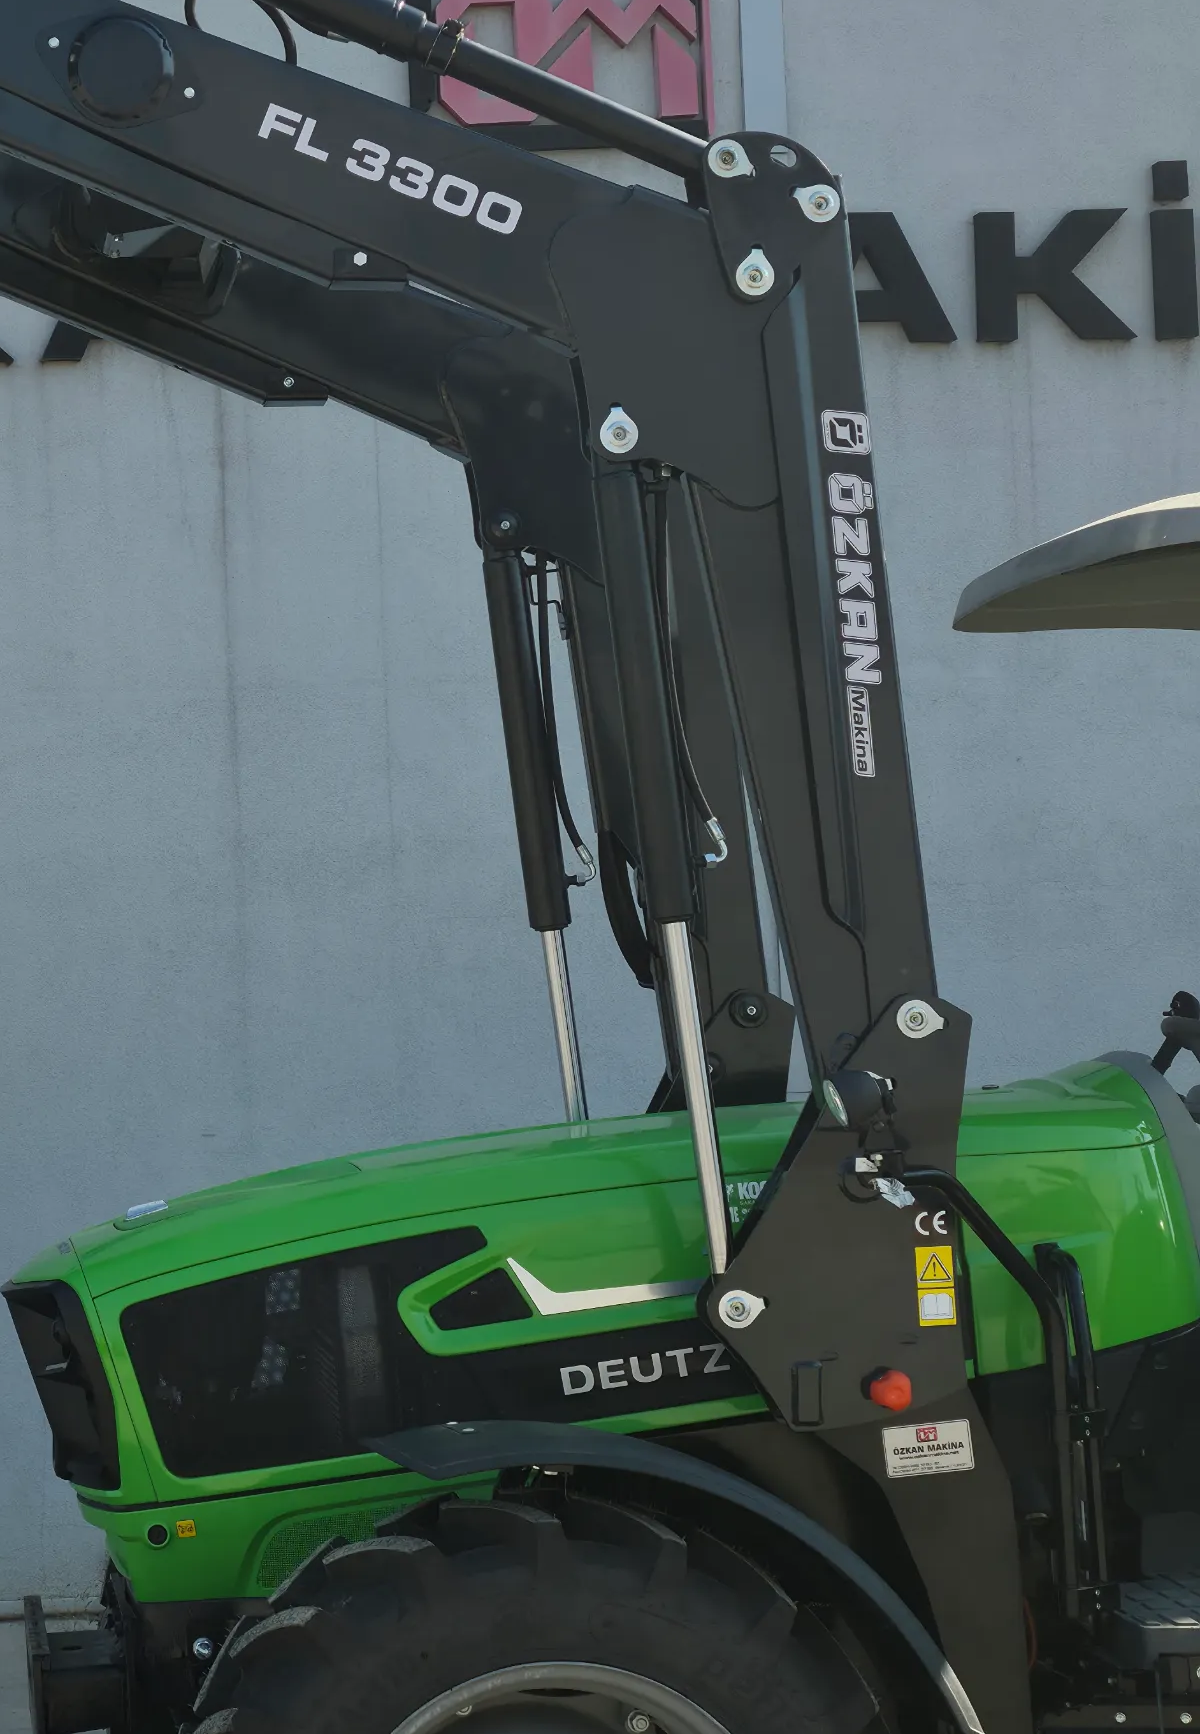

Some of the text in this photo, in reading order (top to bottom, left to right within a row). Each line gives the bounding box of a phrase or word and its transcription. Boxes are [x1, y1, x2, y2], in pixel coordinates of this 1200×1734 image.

[257, 102, 523, 235] FL 3300
[828, 472, 882, 774] ÖZKAN Makina
[915, 1210, 948, 1235] CE
[560, 1342, 731, 1396] DEUTZ
[893, 1445, 925, 1456] ÖZKAN
